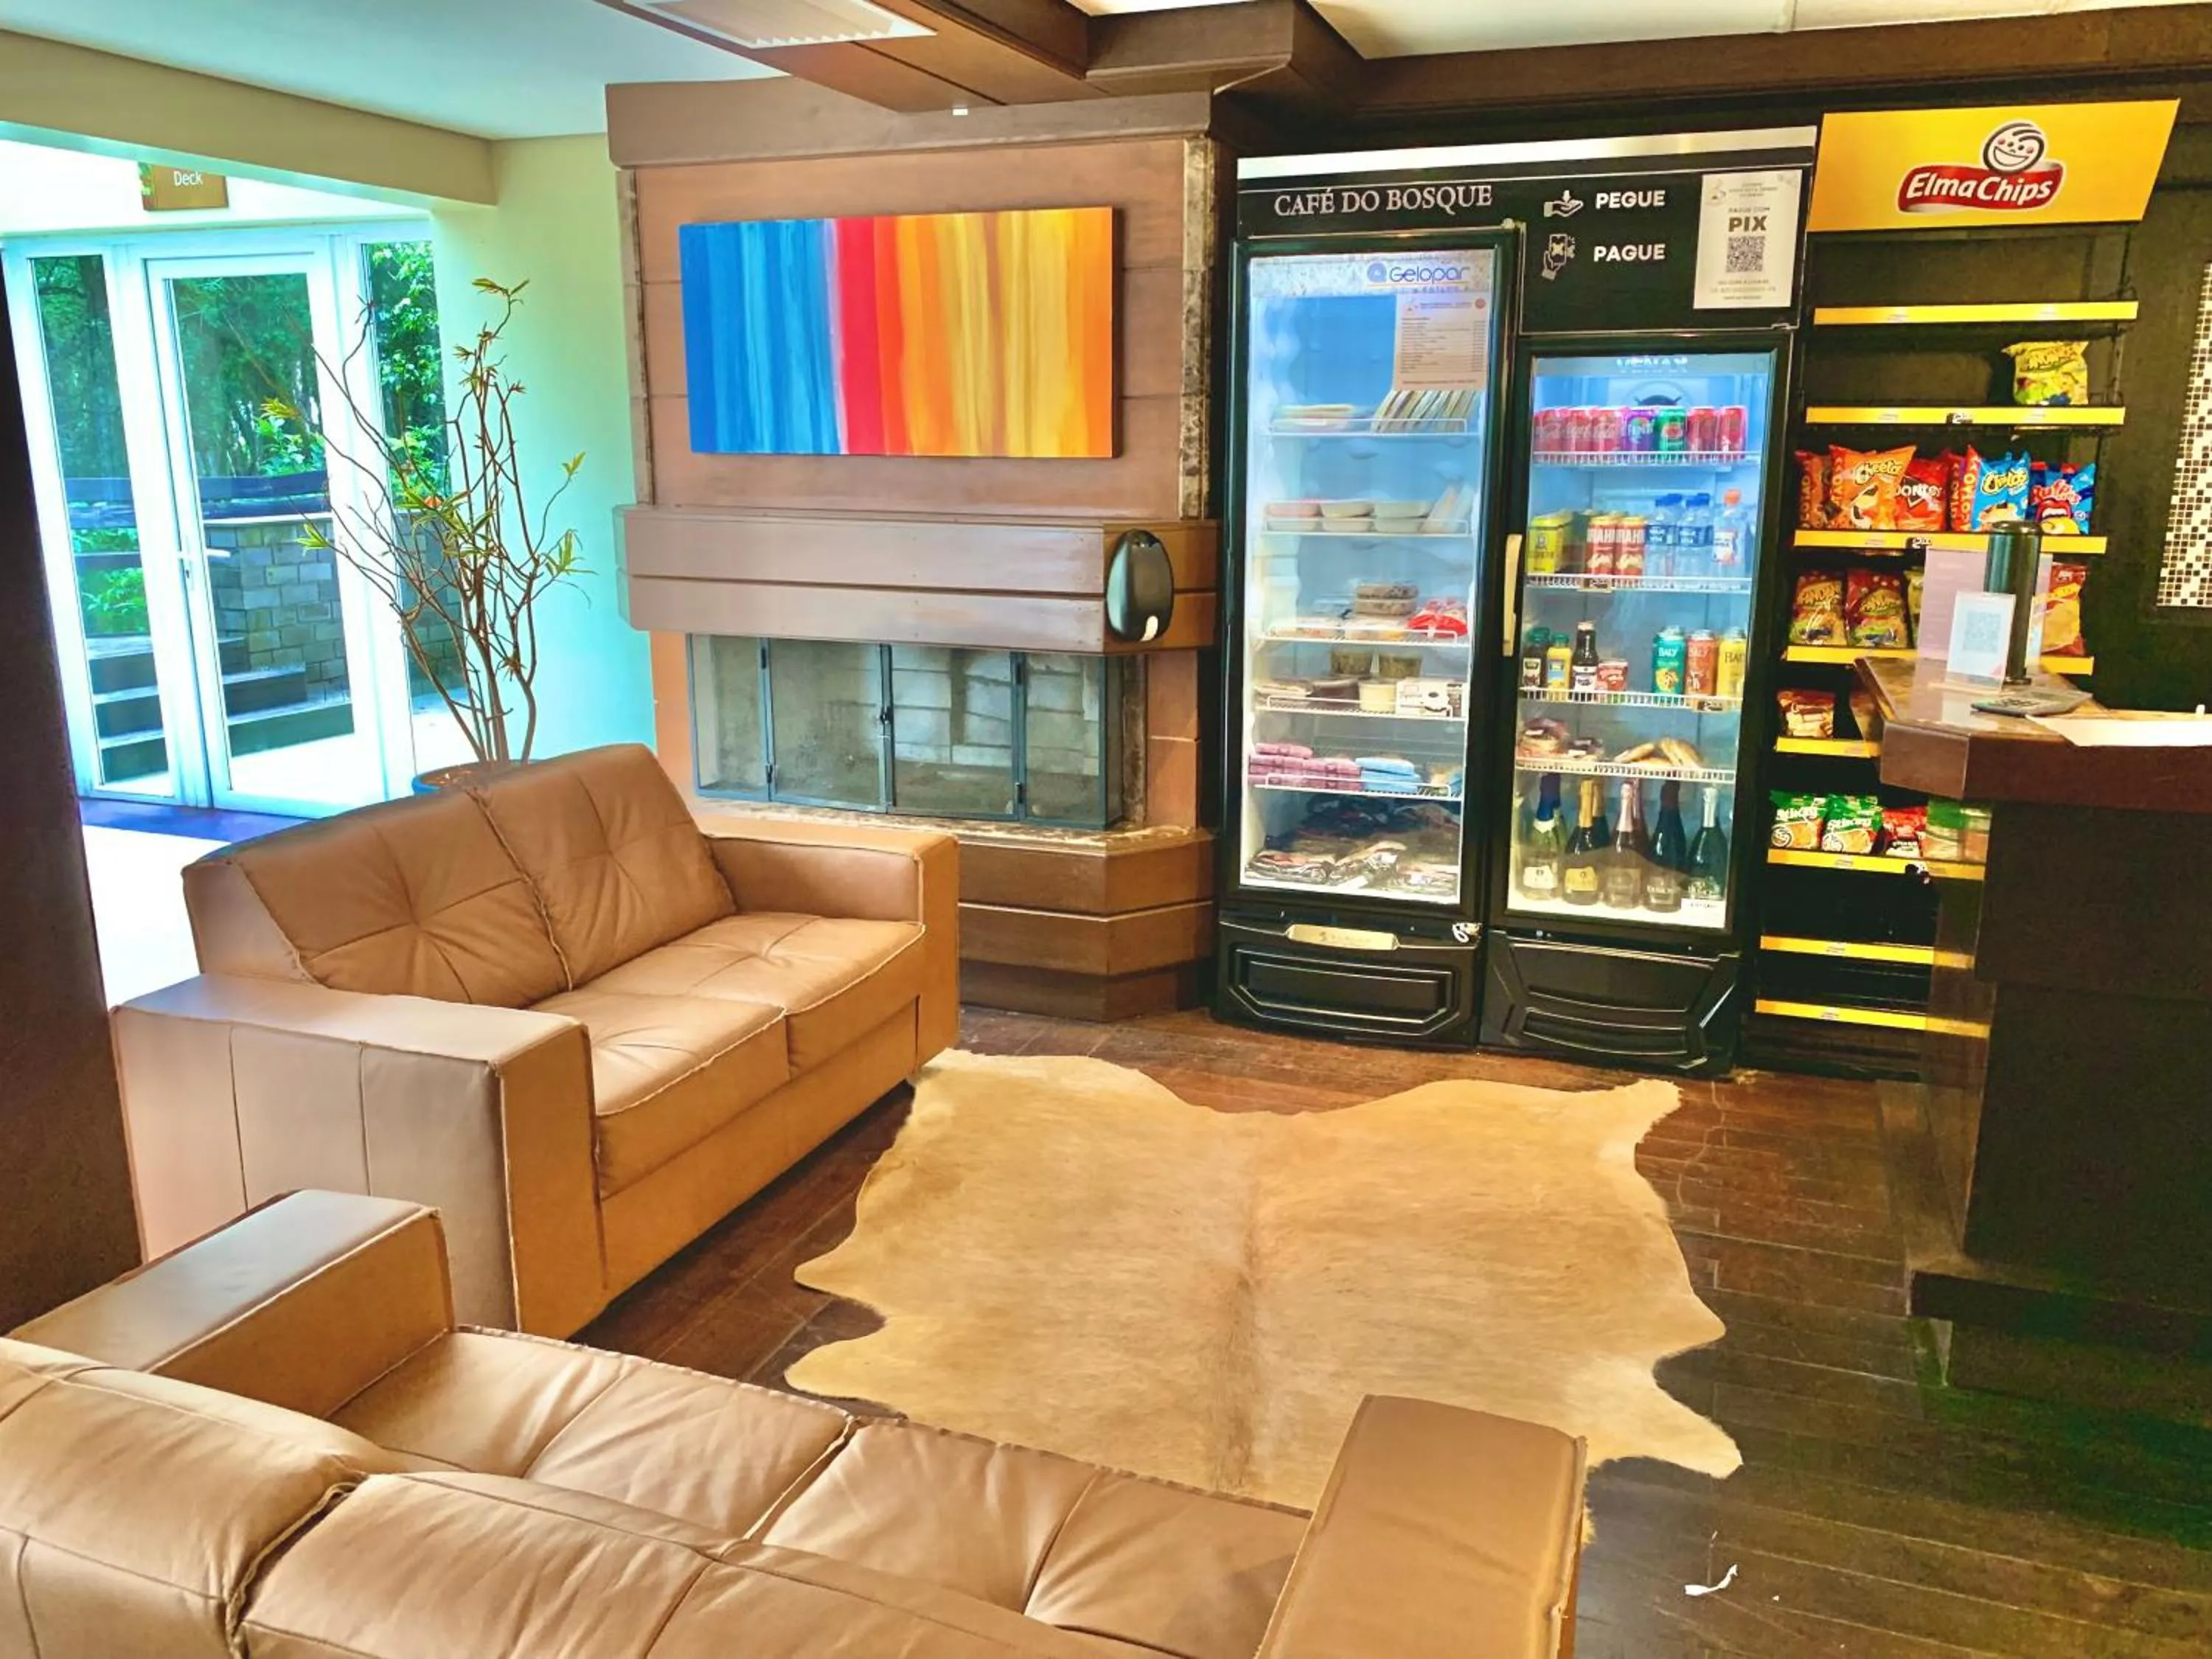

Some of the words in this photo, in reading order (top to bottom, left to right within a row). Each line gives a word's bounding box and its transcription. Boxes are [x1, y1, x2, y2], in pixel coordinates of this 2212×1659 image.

[173, 170, 204, 187] Deck
[1274, 187, 1335, 216] CAFÉ
[1342, 191, 1380, 213] DO
[1386, 185, 1493, 215] BOSQUE
[1595, 189, 1666, 209] PEGUE
[1728, 215, 1767, 232] PIX
[1593, 244, 1666, 262] PAGUE
[1389, 265, 1470, 284] Gelopar
